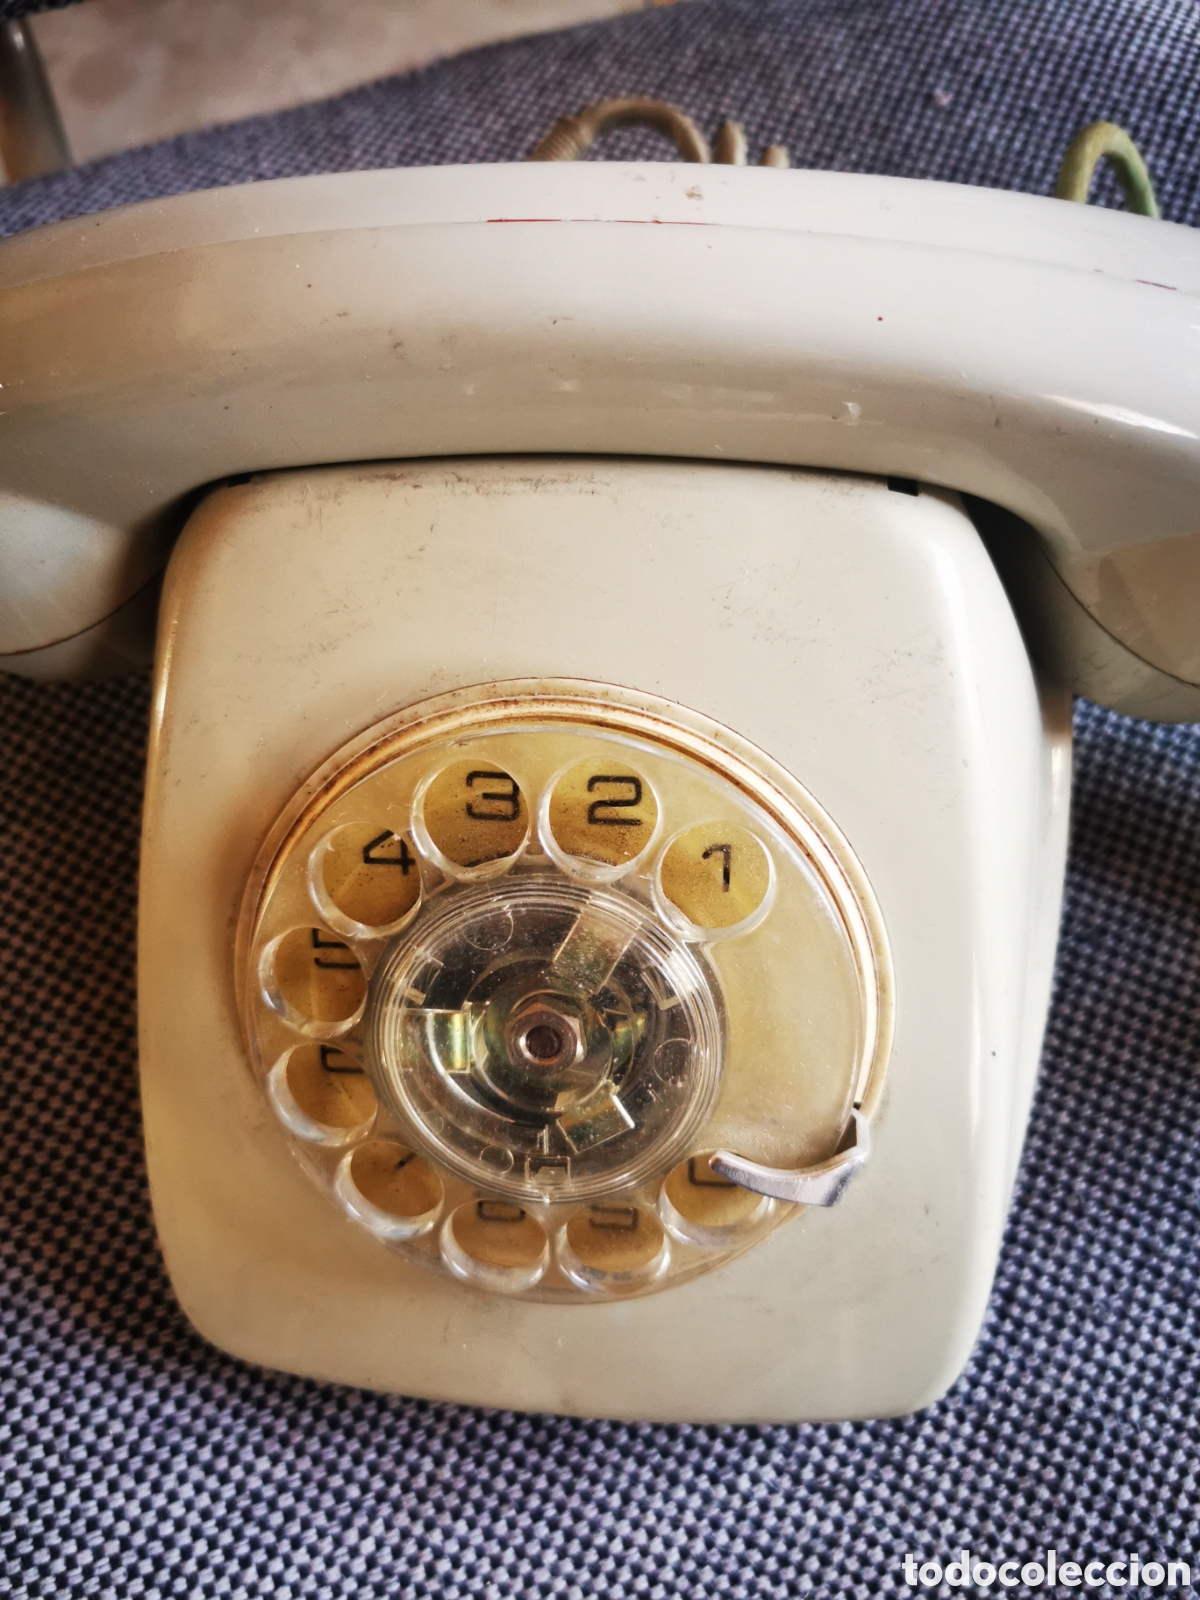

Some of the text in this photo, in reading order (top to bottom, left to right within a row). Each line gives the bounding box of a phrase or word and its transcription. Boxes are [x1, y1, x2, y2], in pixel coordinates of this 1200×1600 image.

[466, 770, 520, 821] 3
[587, 775, 643, 825] 2
[362, 829, 415, 876] 4
[701, 844, 731, 893] 1
